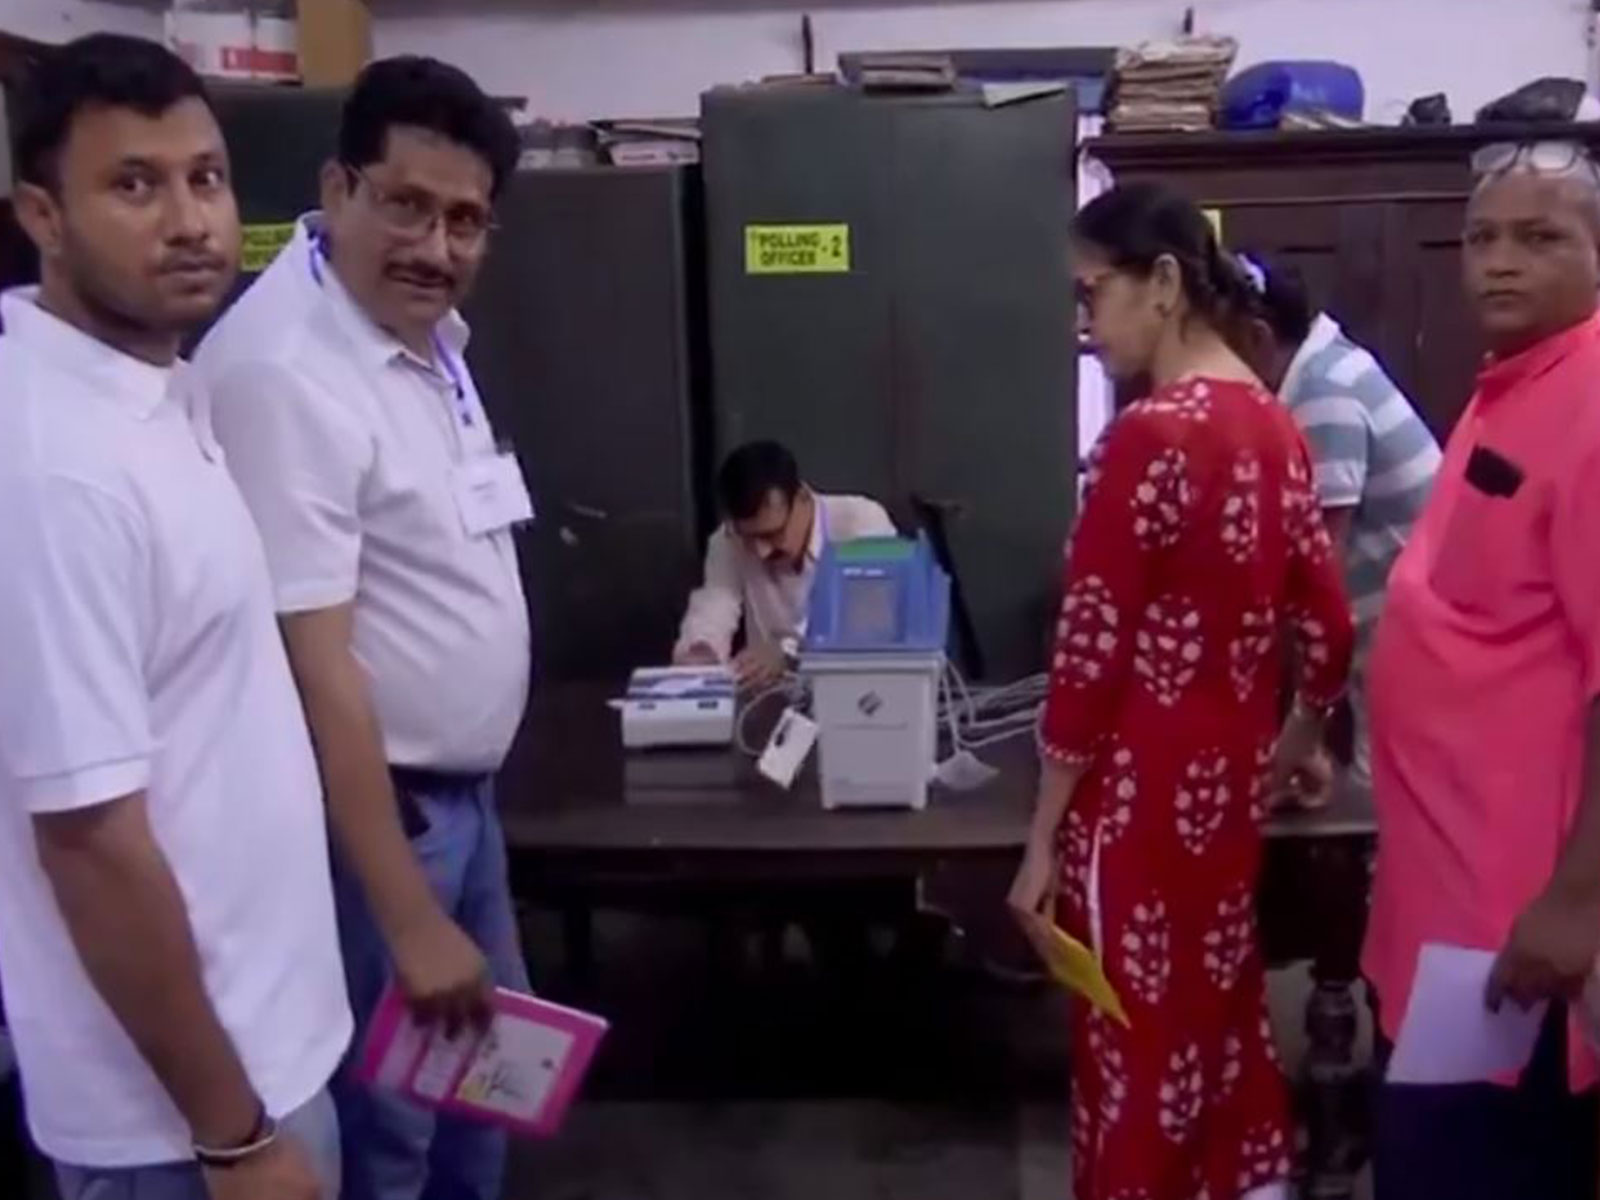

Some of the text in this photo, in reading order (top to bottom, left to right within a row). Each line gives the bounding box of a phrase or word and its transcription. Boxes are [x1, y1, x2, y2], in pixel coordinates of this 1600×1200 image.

[760, 232, 819, 249] POLLING
[832, 234, 842, 258] 2
[760, 250, 817, 266] OFFICER
